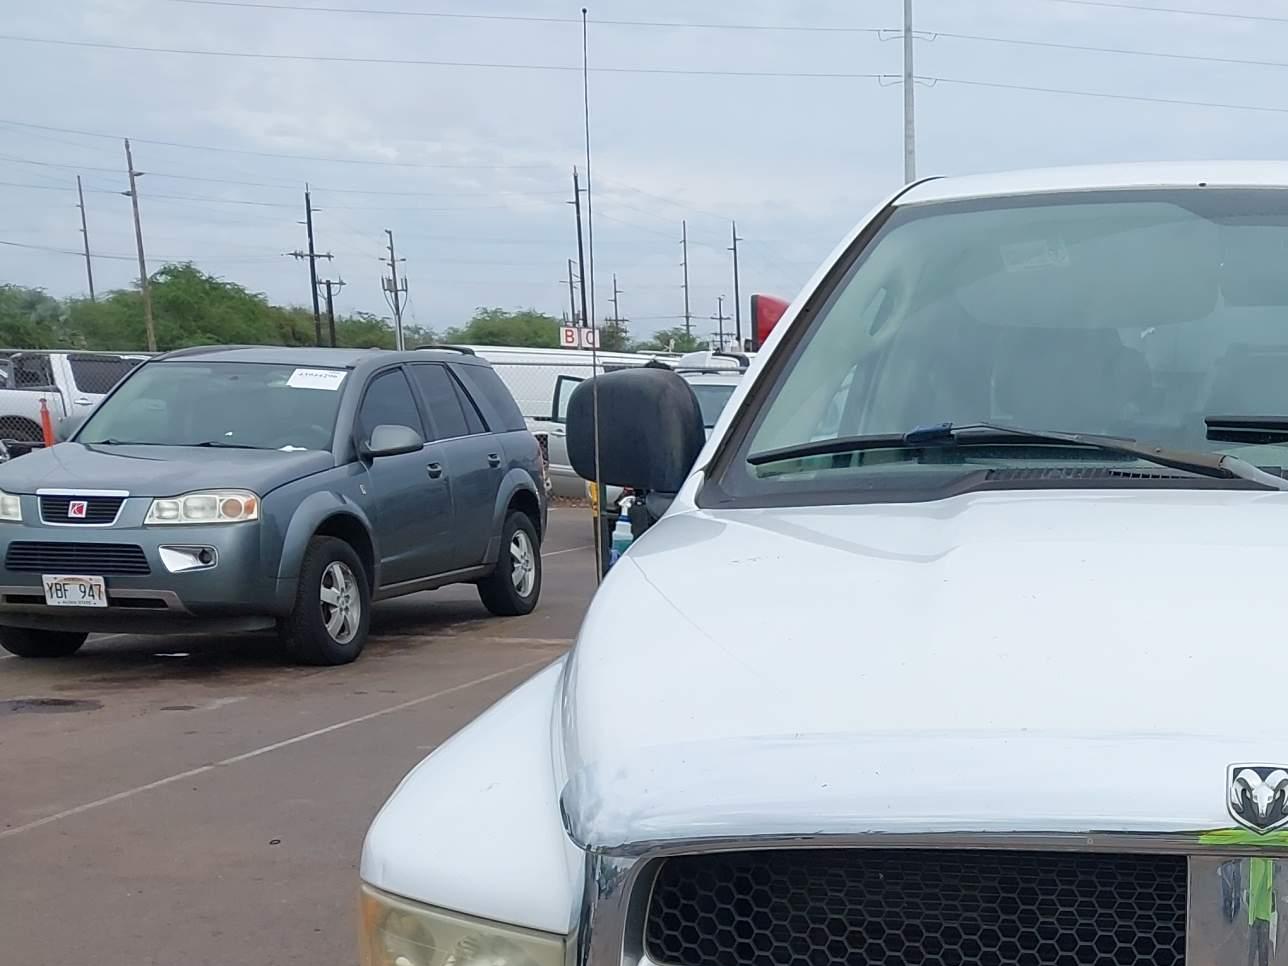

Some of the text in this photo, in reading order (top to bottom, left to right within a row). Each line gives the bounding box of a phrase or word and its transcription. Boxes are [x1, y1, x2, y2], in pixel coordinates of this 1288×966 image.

[565, 329, 575, 344] B
[46, 582, 102, 601] YBF 947
